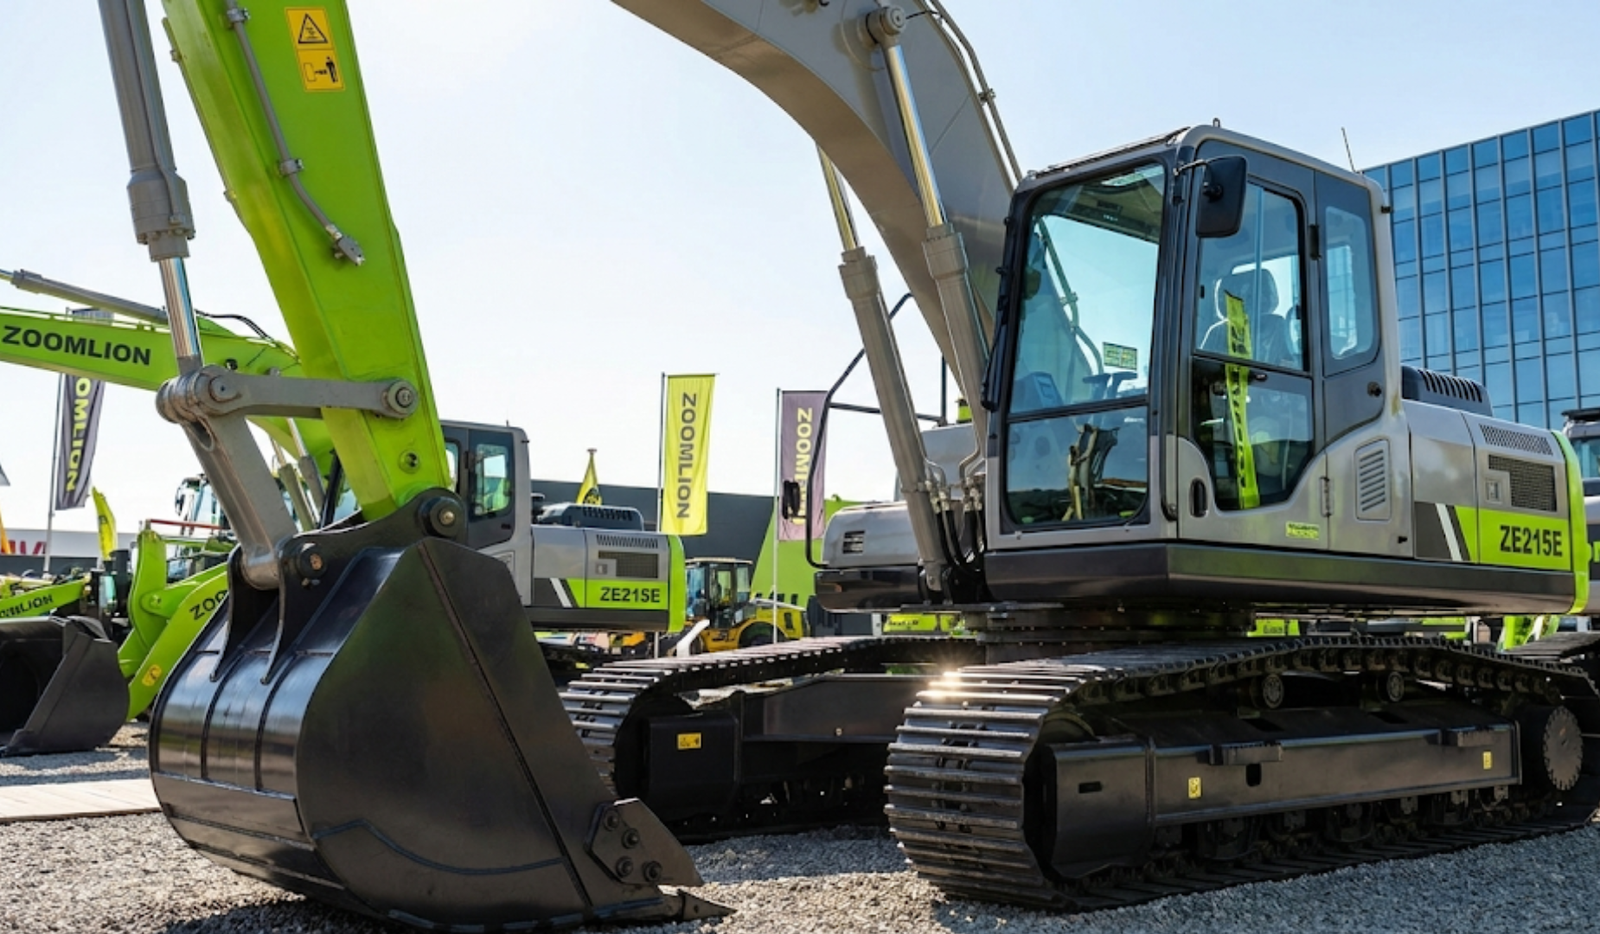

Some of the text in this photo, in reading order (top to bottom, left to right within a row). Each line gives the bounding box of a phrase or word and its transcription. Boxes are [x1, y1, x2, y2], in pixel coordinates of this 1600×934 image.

[2, 325, 152, 366] ZOOMLION
[676, 392, 697, 519] ZOOMLION
[1499, 525, 1563, 557] ZE215E
